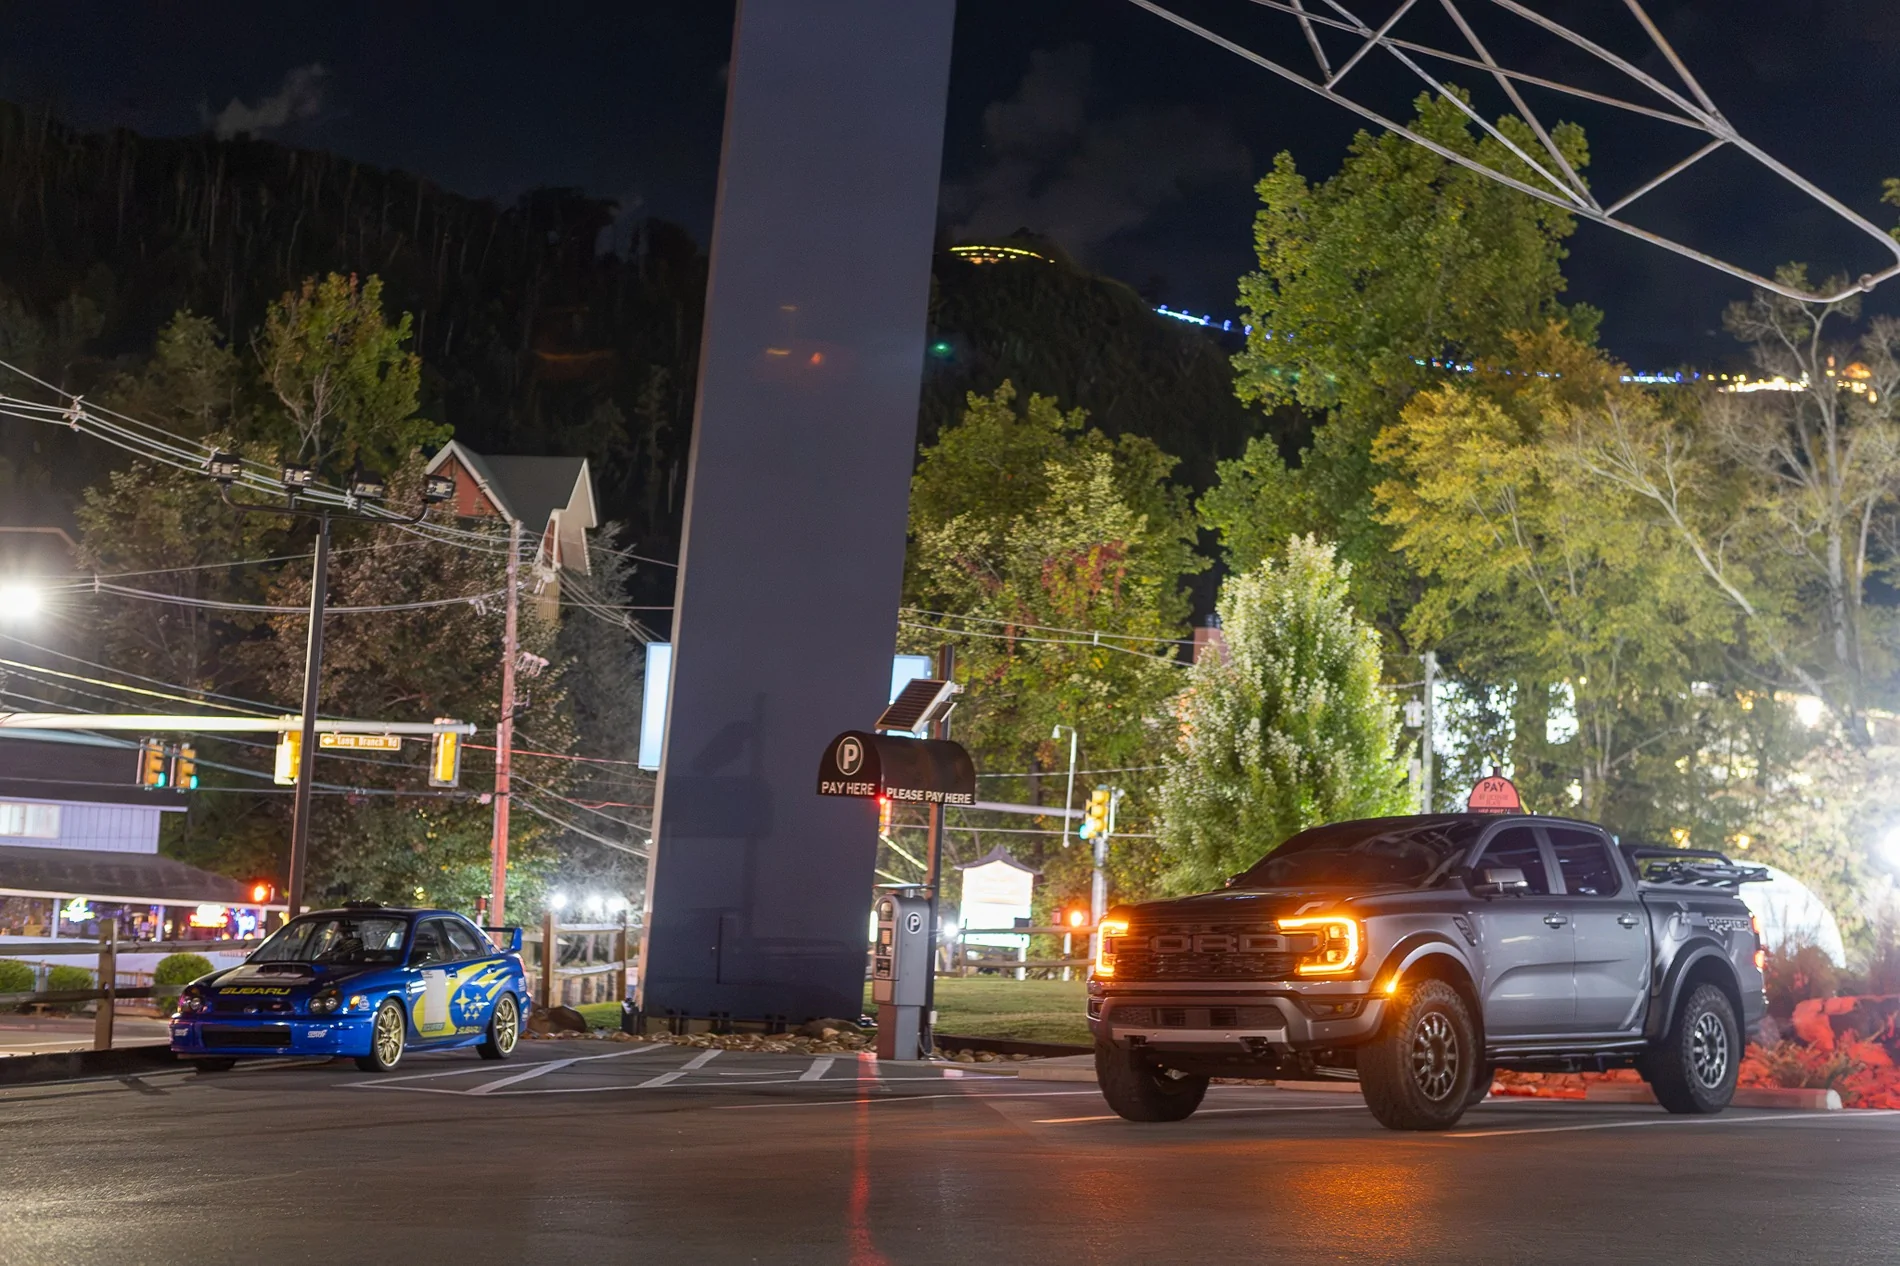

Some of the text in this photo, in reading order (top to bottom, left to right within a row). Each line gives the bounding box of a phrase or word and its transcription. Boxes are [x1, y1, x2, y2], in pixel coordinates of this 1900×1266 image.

[337, 736, 397, 747] Long Branch Rd
[842, 744, 859, 770] P
[821, 781, 875, 796] PAY HERE
[1484, 781, 1505, 792] PAY
[886, 787, 972, 804] PLEASE PAY HERE
[910, 916, 920, 931] P
[1705, 916, 1751, 935] RAPTOR
[1112, 934, 1288, 953] FORD
[219, 987, 291, 995] SUBARU
